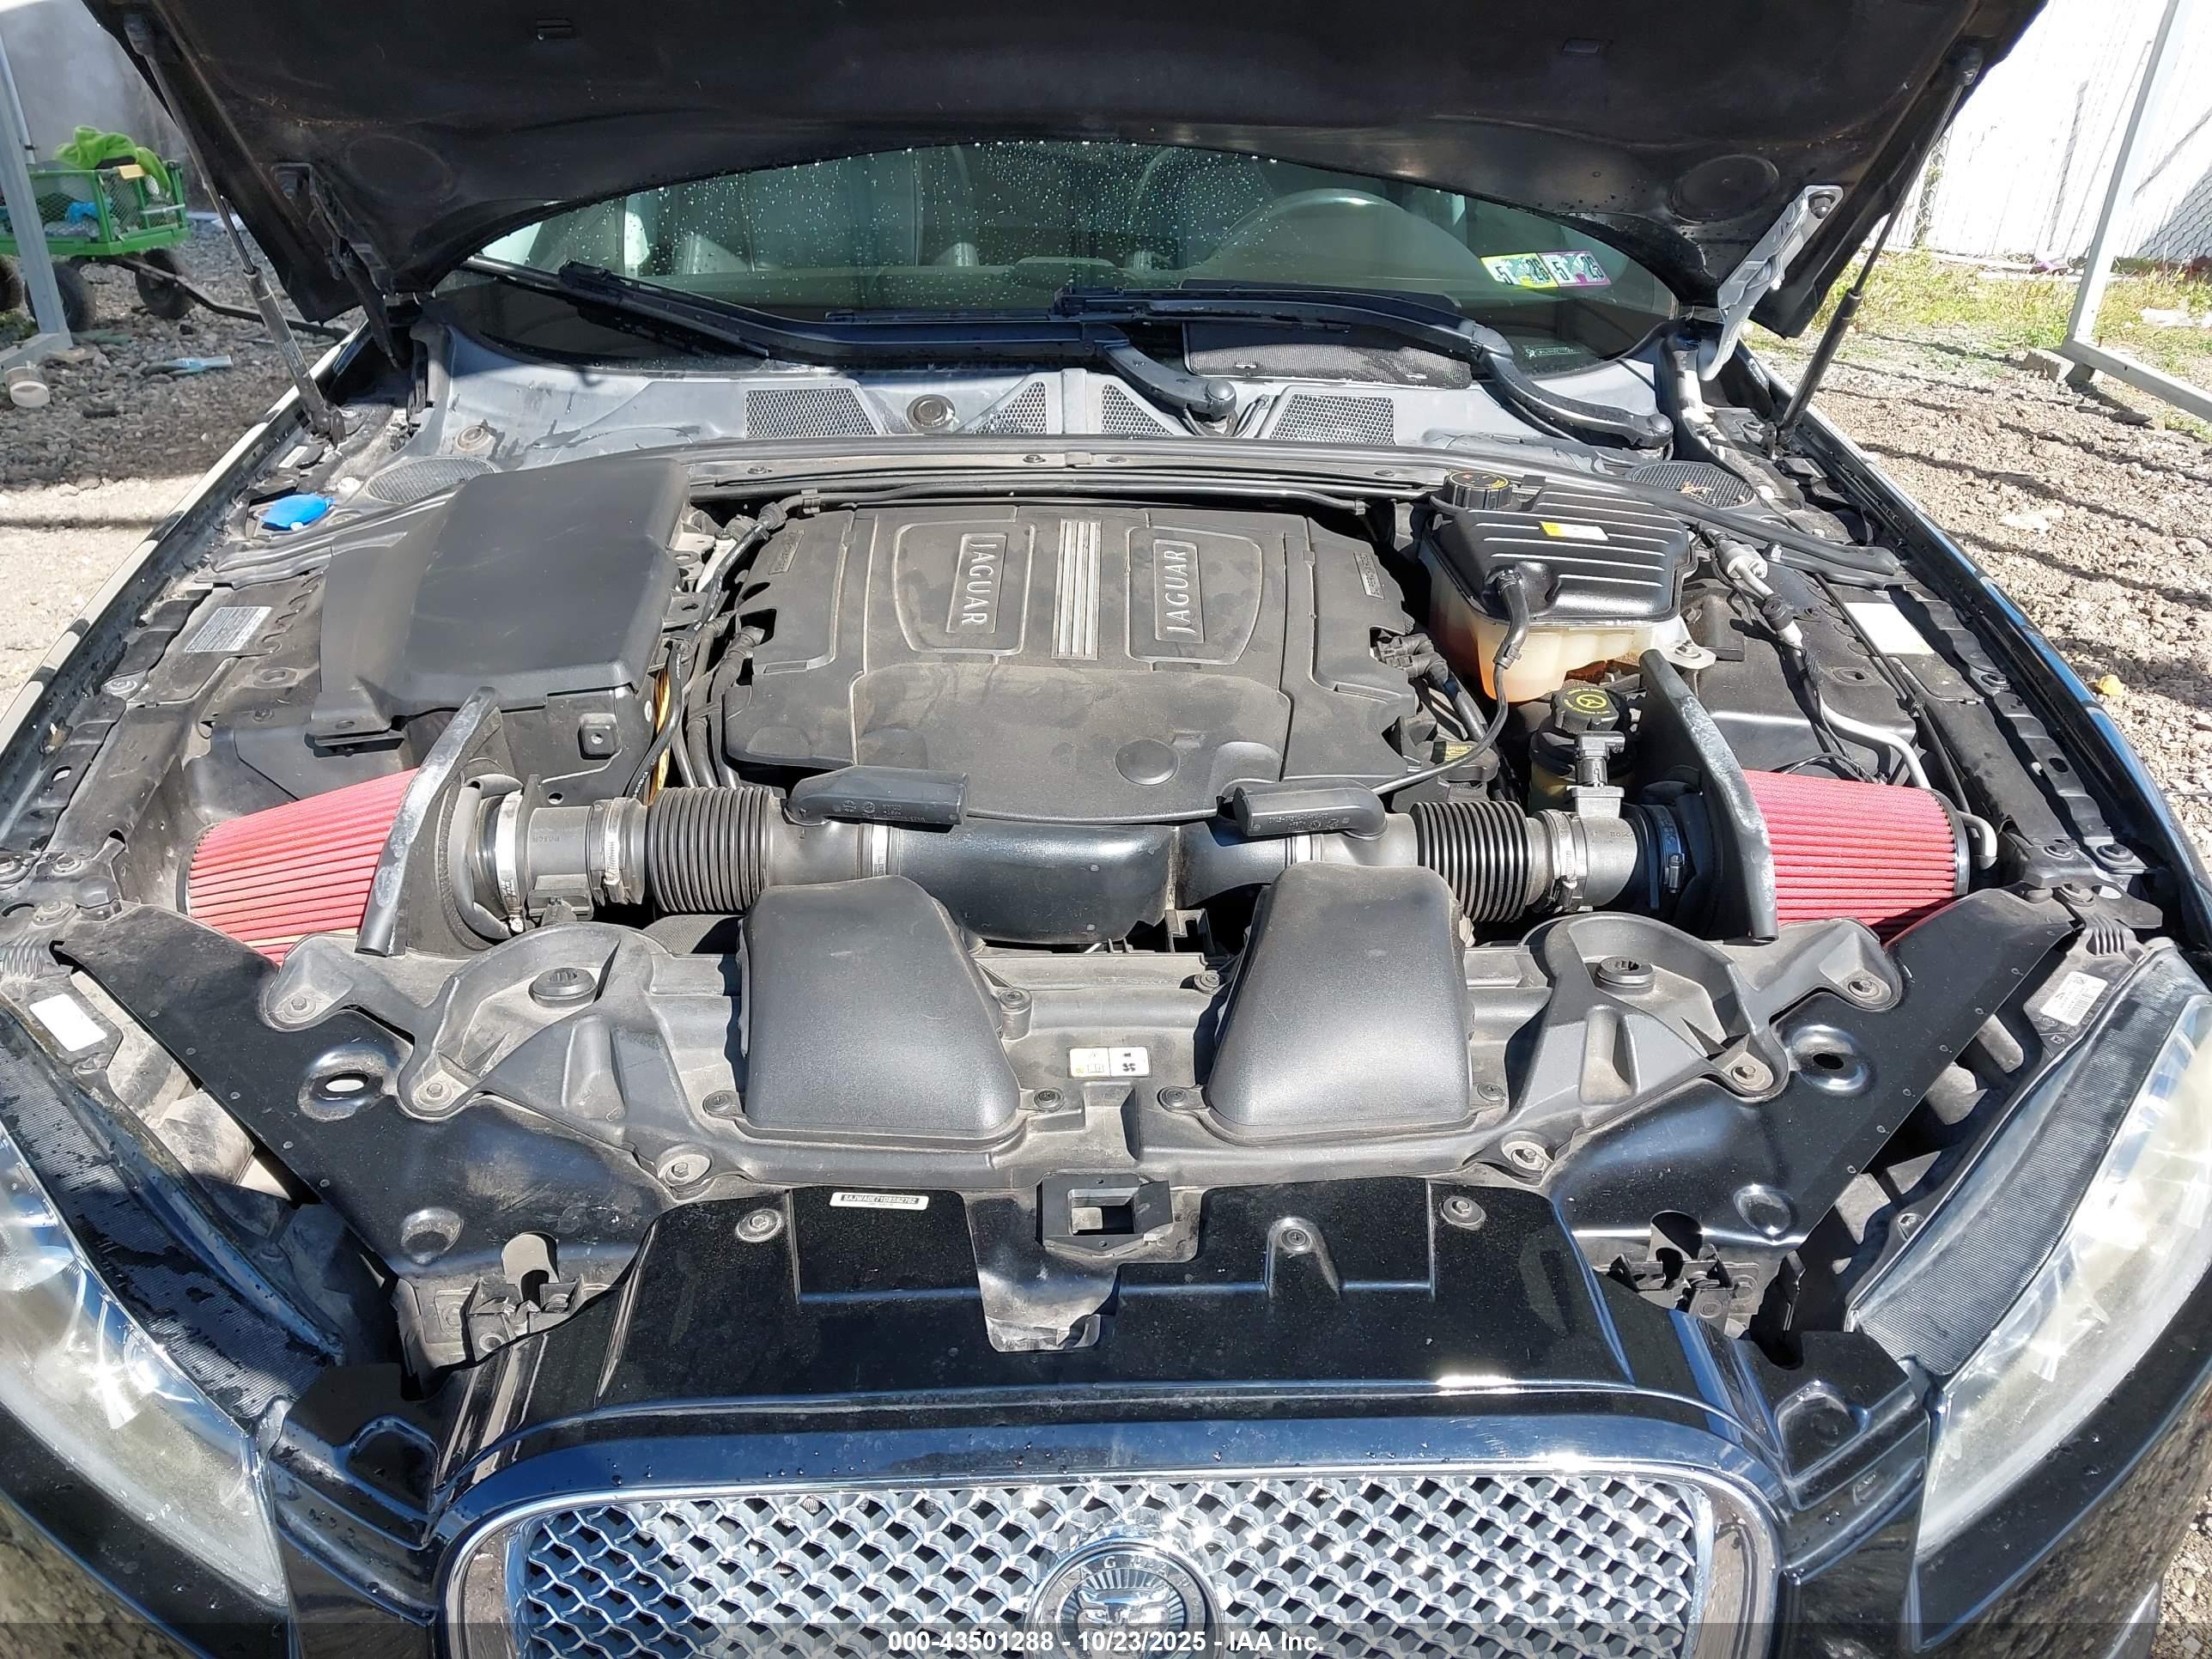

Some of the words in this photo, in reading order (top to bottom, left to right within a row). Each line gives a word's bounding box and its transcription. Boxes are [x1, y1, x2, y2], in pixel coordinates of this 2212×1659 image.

[1495, 265, 1514, 285] 5
[1553, 261, 1570, 281] 5
[962, 543, 997, 625] JAGUAR
[1164, 550, 1196, 635] JAGUAR
